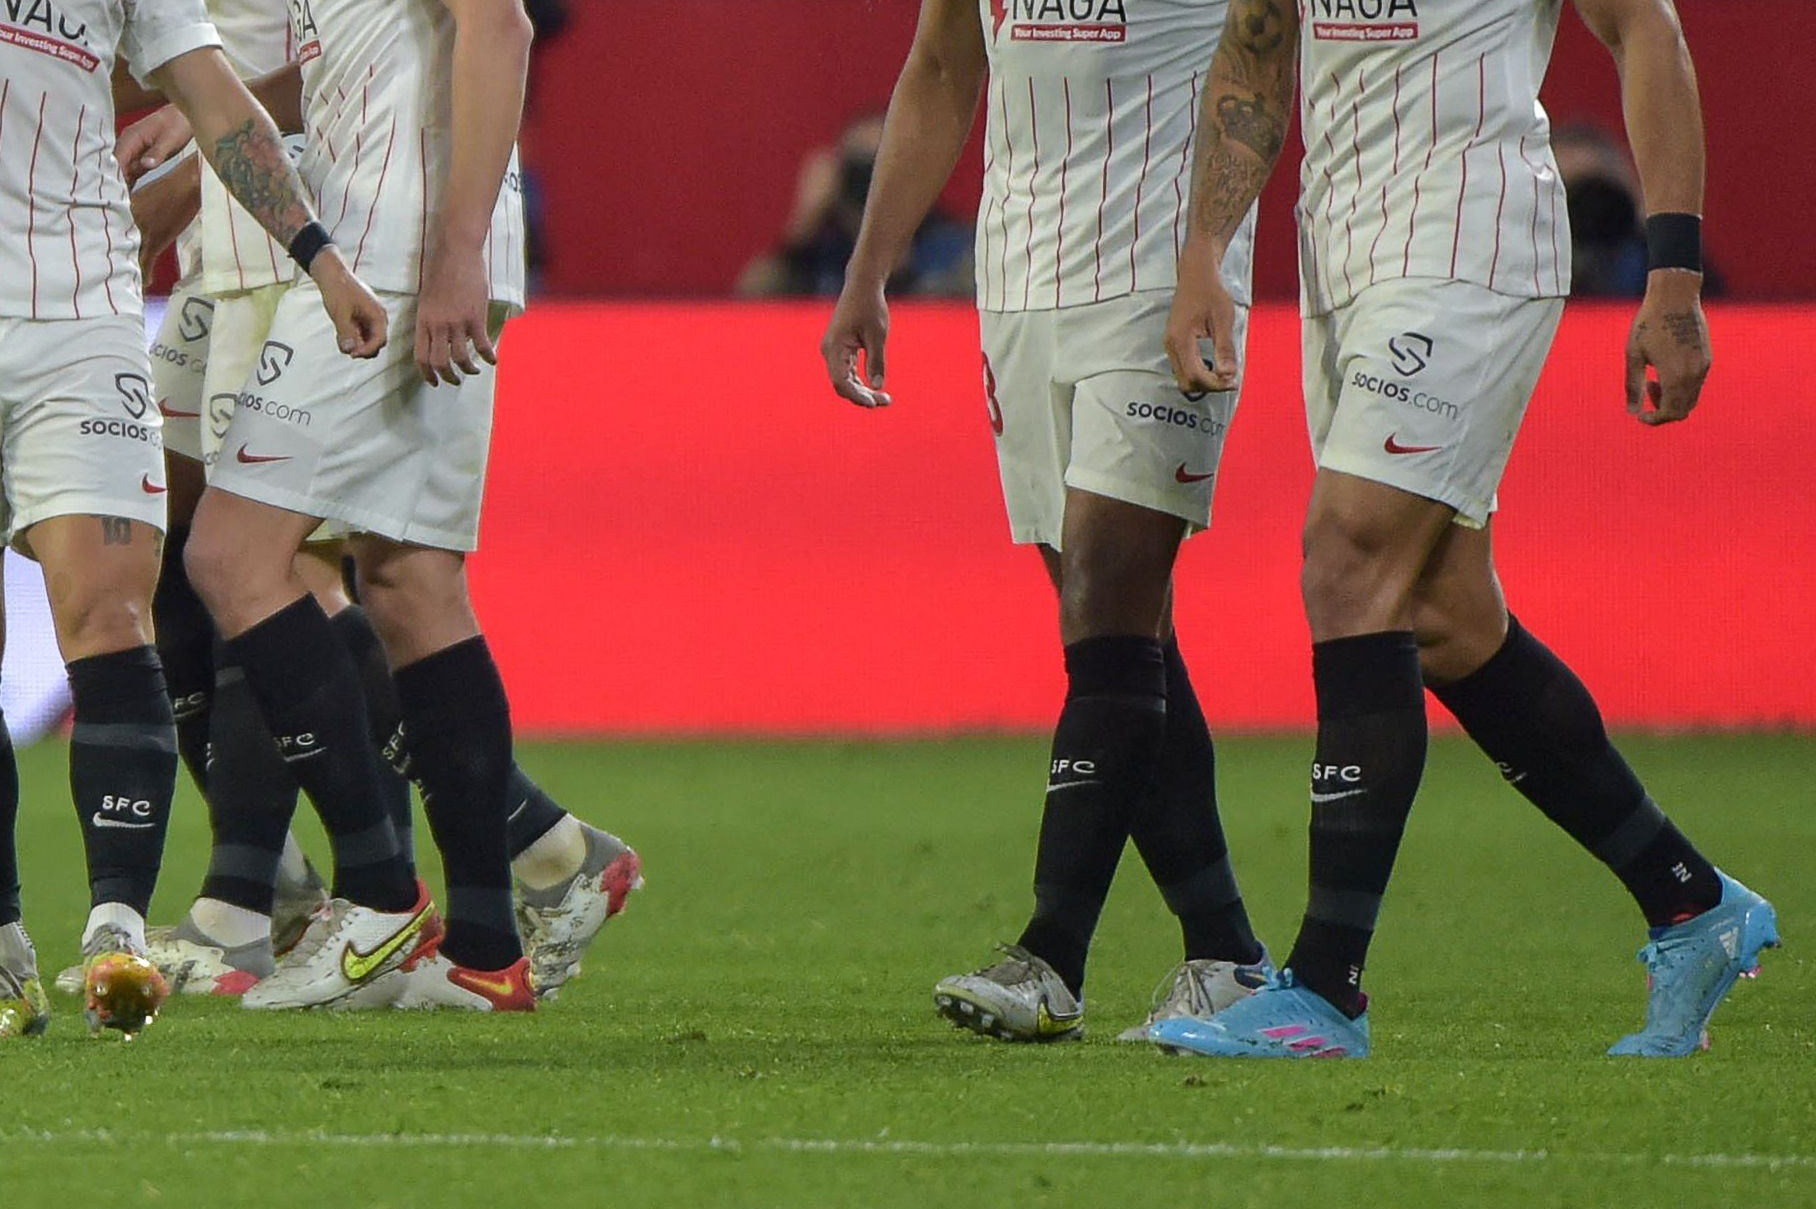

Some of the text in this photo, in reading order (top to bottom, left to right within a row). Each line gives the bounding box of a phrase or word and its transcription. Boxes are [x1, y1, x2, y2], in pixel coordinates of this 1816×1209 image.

[1099, 28, 1122, 40] App
[1312, 762, 1362, 783] SFC
[102, 794, 152, 817] SFC
